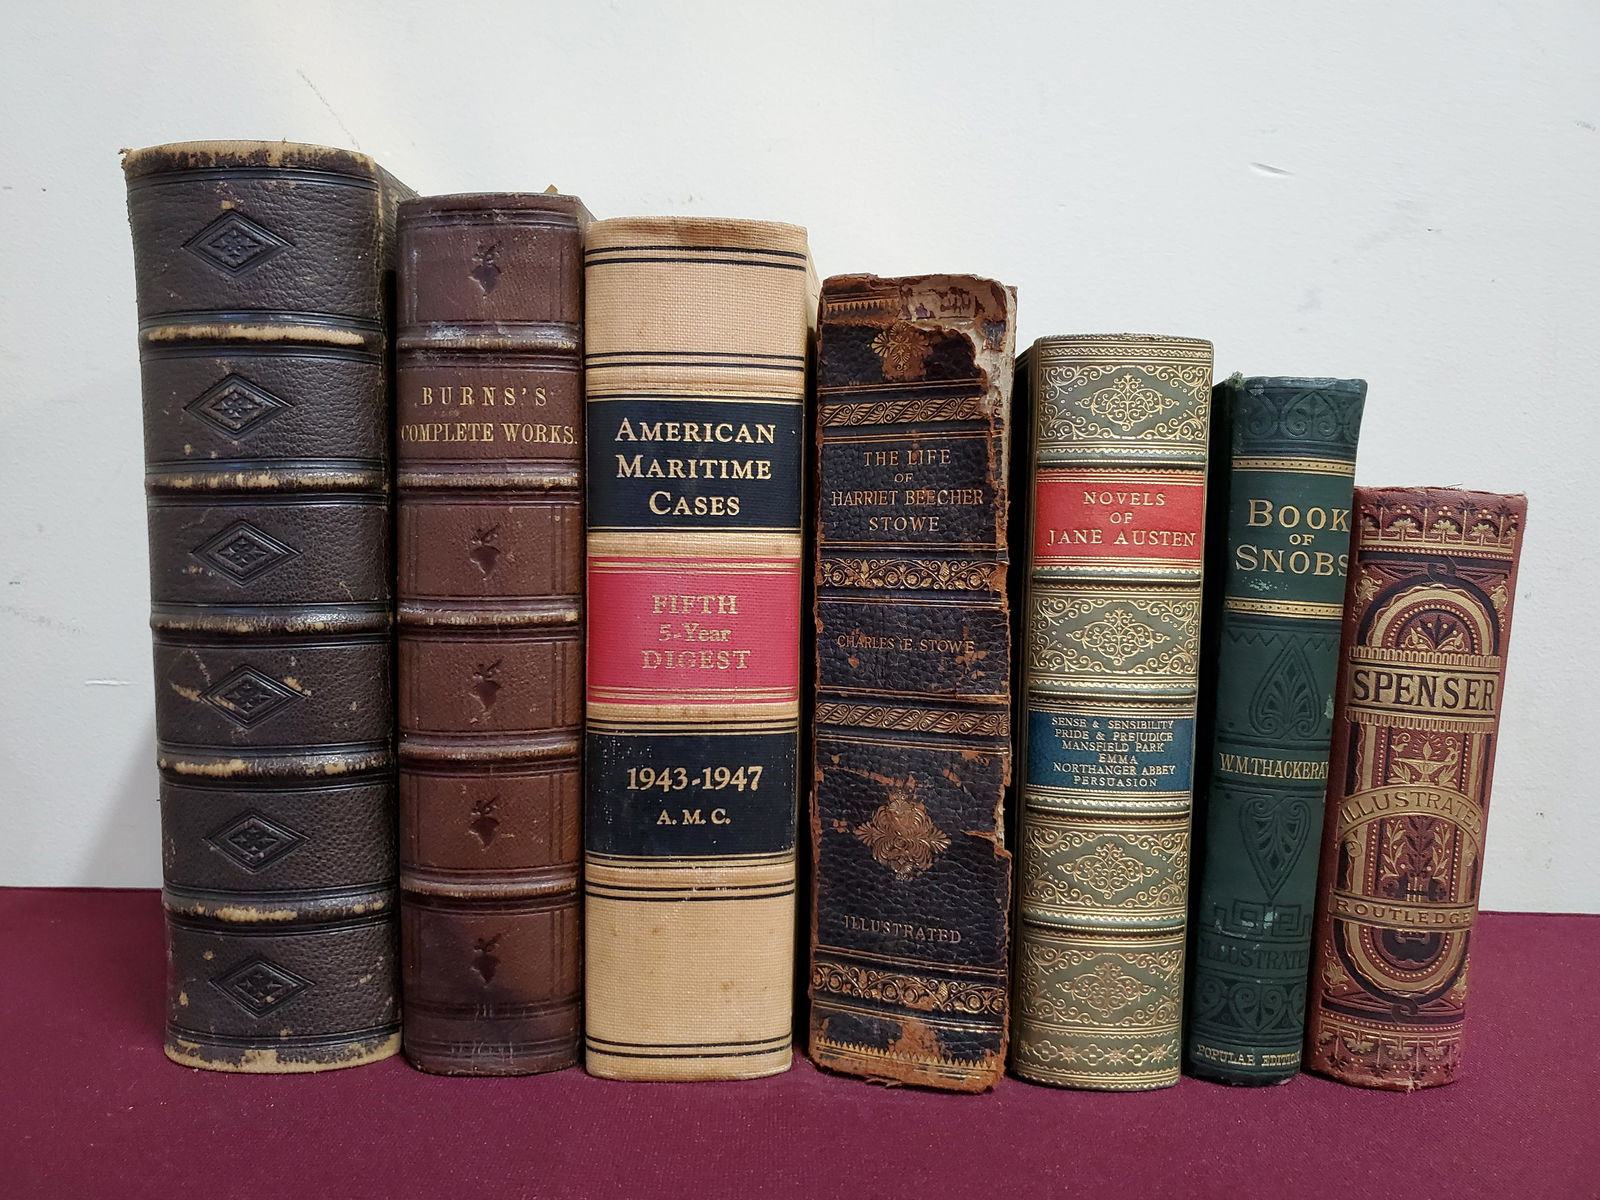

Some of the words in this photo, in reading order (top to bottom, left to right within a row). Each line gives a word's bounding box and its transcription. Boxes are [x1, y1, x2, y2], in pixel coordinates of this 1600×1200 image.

[421, 386, 547, 407] BURNS'S
[401, 423, 494, 443] COMPLETE
[501, 423, 578, 445] WORKS.
[614, 417, 776, 444] AMERICAN
[615, 454, 772, 480] MARITIME
[863, 450, 900, 467] THE
[906, 449, 951, 465] LIFE
[894, 473, 914, 483] OF
[649, 491, 740, 516] CASES
[831, 489, 899, 507] HARRIET
[904, 489, 984, 505] BEECHER
[1083, 491, 1166, 506] NOVELS
[869, 516, 940, 532] STOWE
[1109, 512, 1133, 524] OF
[1246, 499, 1350, 532] BOOK
[1047, 529, 1103, 546] JANE
[1113, 530, 1196, 547] AUSTEN
[1288, 533, 1315, 546] OF
[1235, 544, 1349, 577] SNOBS
[652, 594, 739, 615] FIFTH
[658, 622, 732, 642] 5-Year
[837, 635, 895, 649] CHARLES
[920, 639, 976, 654] STOWE
[641, 649, 751, 670] DIGEST
[1352, 669, 1495, 711] SPENSER
[1052, 716, 1087, 728] SENSE
[1092, 720, 1100, 729] &
[1107, 720, 1174, 730] SENSIBILITY
[1054, 728, 1089, 740] PRIDE
[1095, 731, 1105, 741] &
[1113, 731, 1174, 742] PREJUDICE
[1062, 740, 1129, 753] MANSFIELD
[1135, 742, 1165, 753] PARK
[1052, 762, 1137, 775] NORTHANGER
[1141, 765, 1176, 776] ABBEY
[1098, 753, 1139, 765] EMMA
[626, 765, 764, 792] 1943-1947
[1073, 775, 1158, 787] PERSUASION
[1340, 791, 1483, 836] ILLUSTRATED
[1336, 899, 1472, 925] ROUTLEDGE
[842, 915, 962, 944] ILLUSTRATED
[1196, 1044, 1256, 1066] POPULAR
